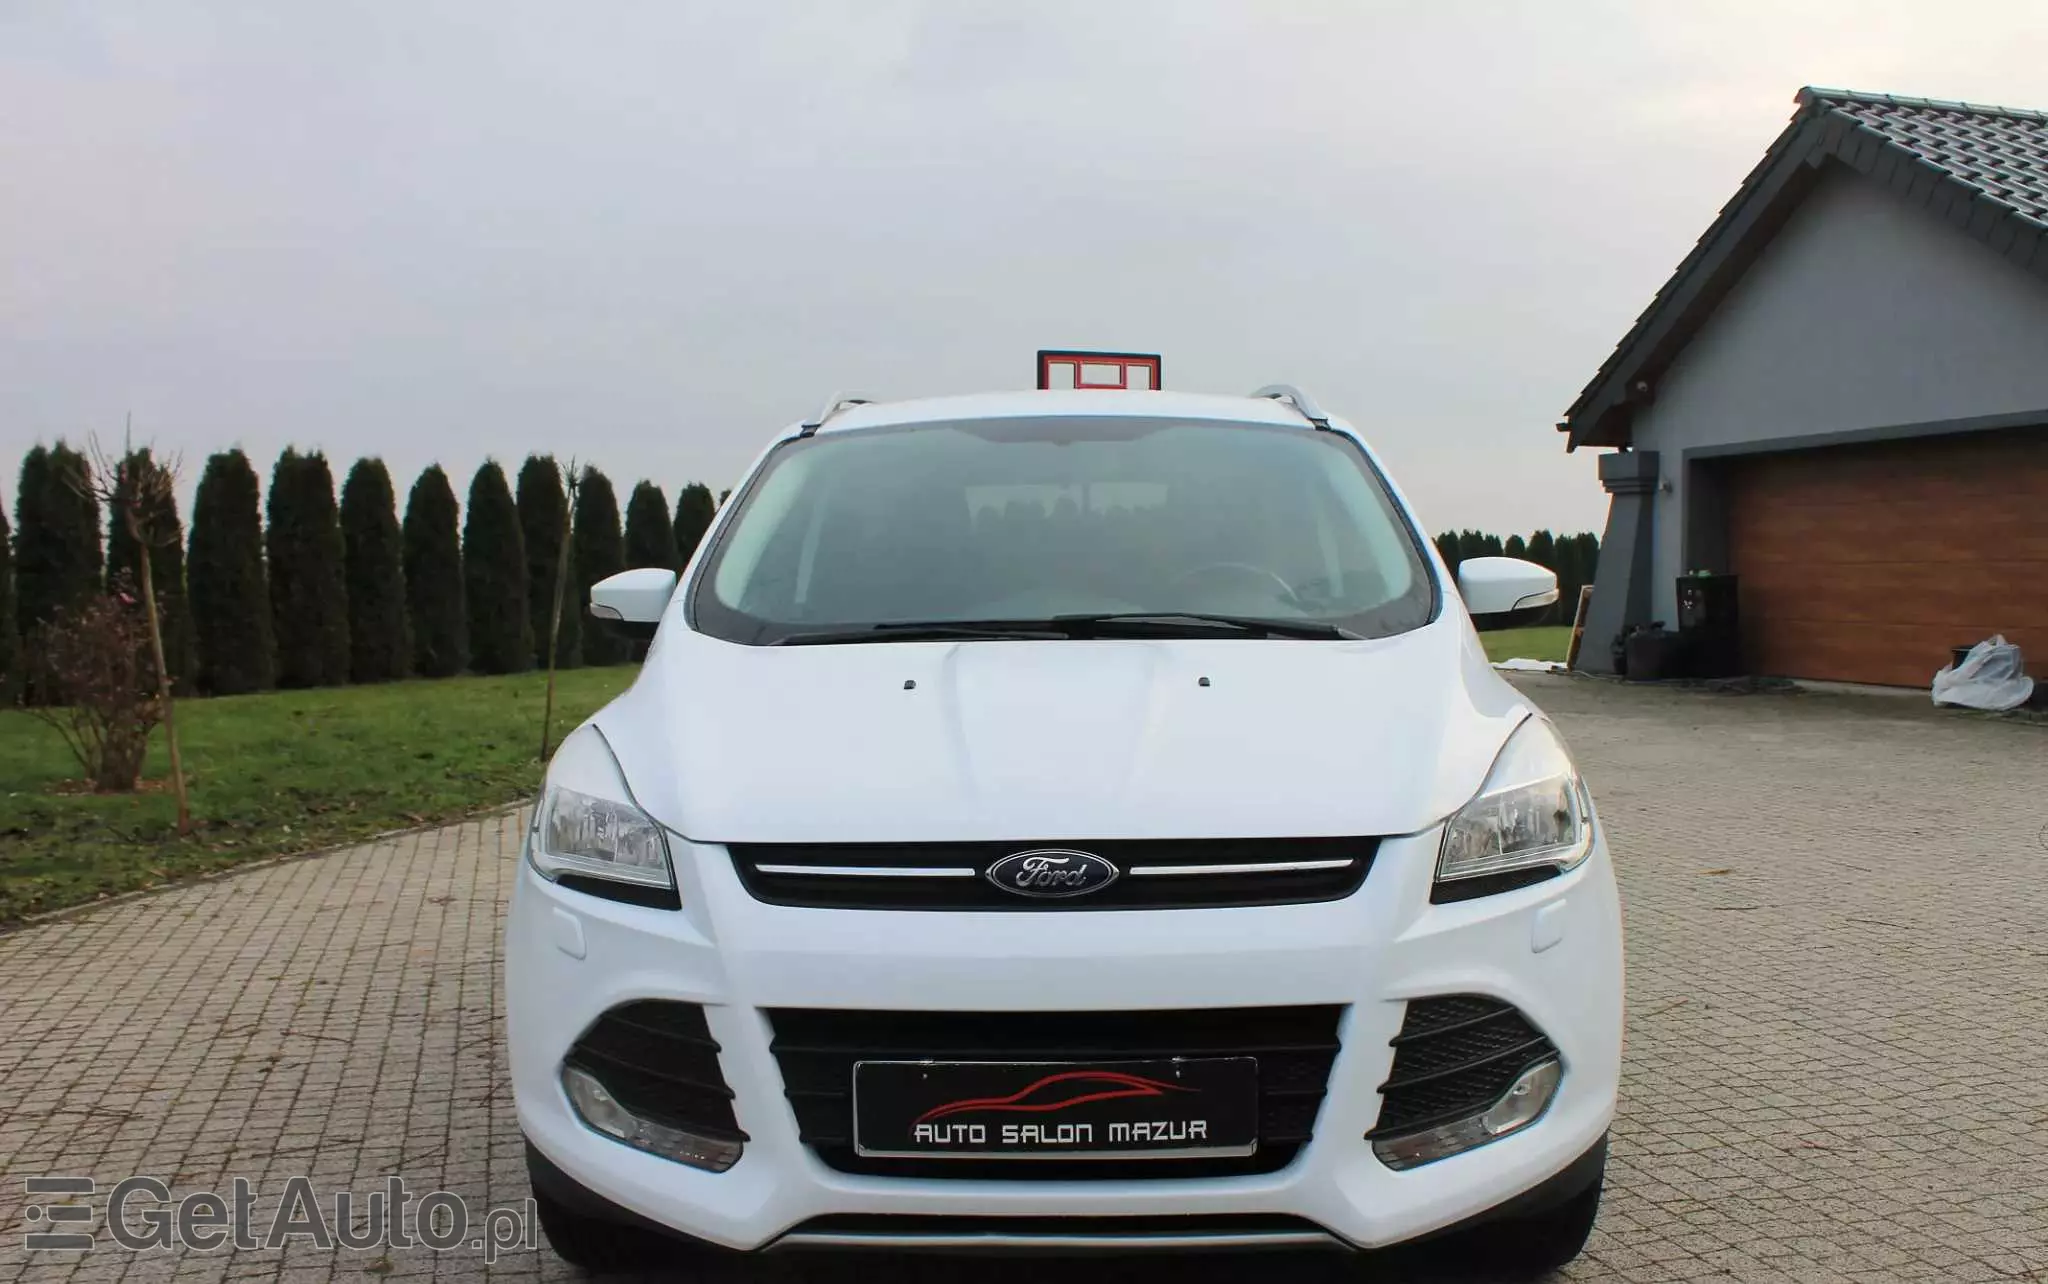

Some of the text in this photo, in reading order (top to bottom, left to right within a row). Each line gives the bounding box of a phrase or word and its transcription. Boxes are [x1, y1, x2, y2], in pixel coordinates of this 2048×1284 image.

[1015, 856, 1088, 887] Ford
[913, 1119, 1208, 1144] AUTO SALON MAZUR
